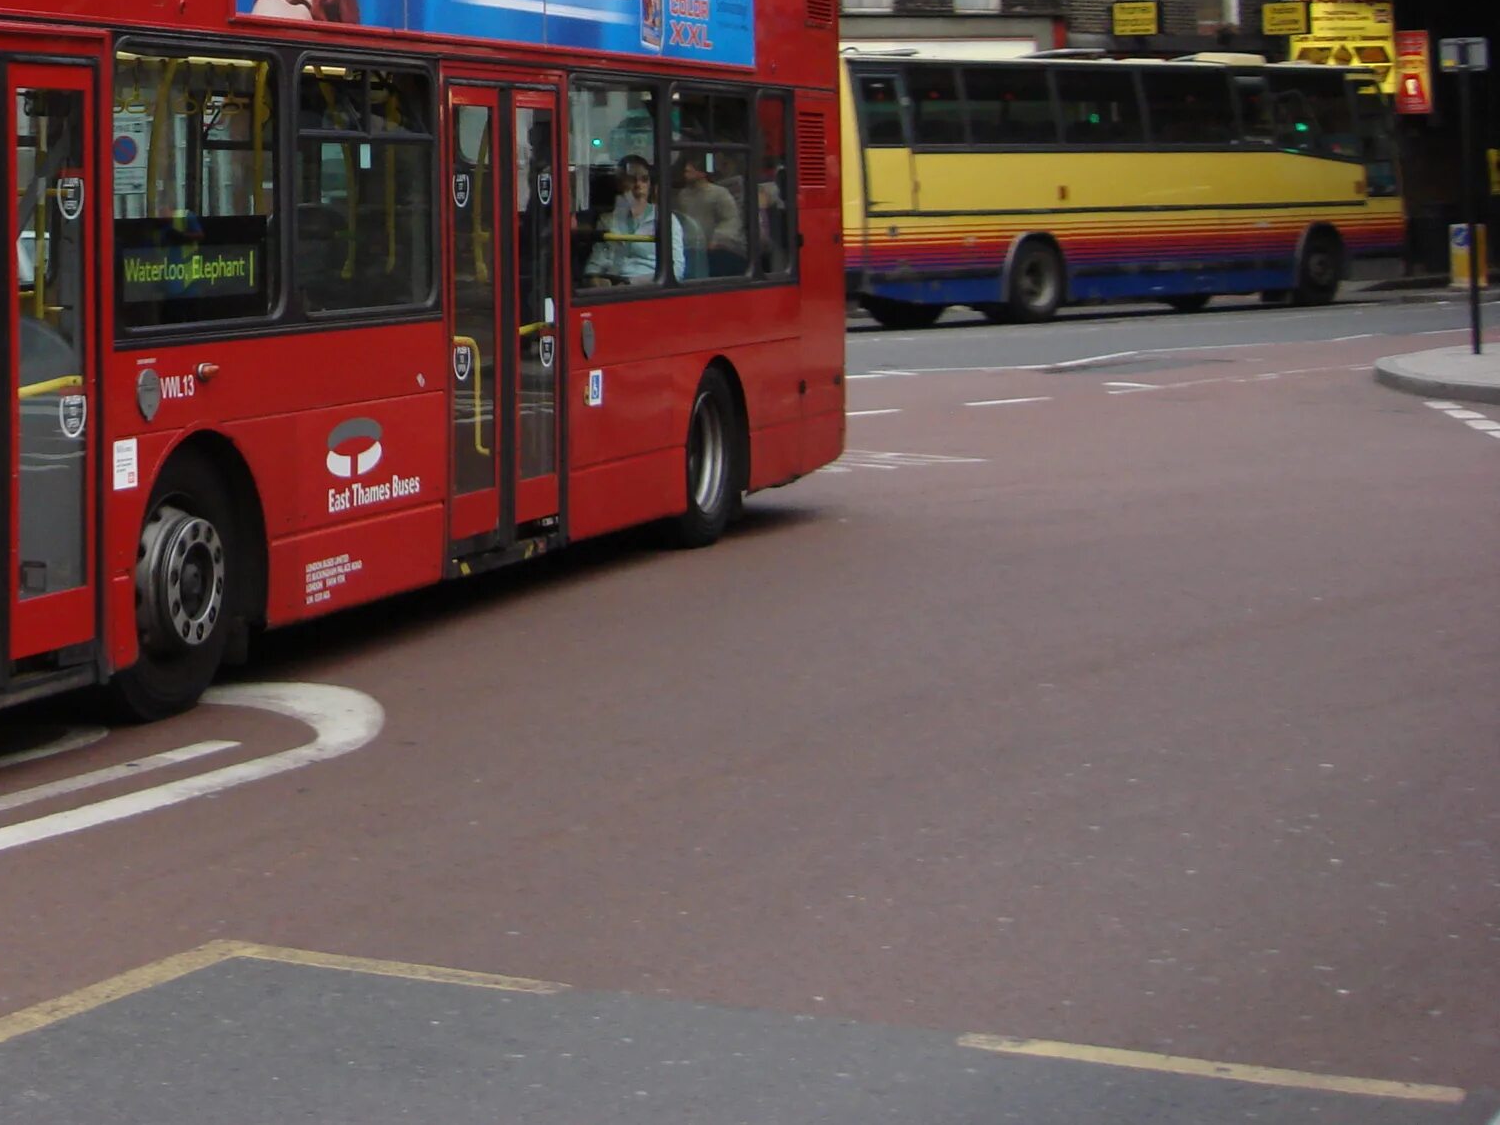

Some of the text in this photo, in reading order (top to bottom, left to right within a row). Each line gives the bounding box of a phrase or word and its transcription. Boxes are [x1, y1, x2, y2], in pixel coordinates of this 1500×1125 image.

[668, 19, 714, 50] XXL
[191, 254, 246, 286] Elephant
[160, 374, 195, 399] VWL13
[328, 474, 420, 513] East Thames Buses
